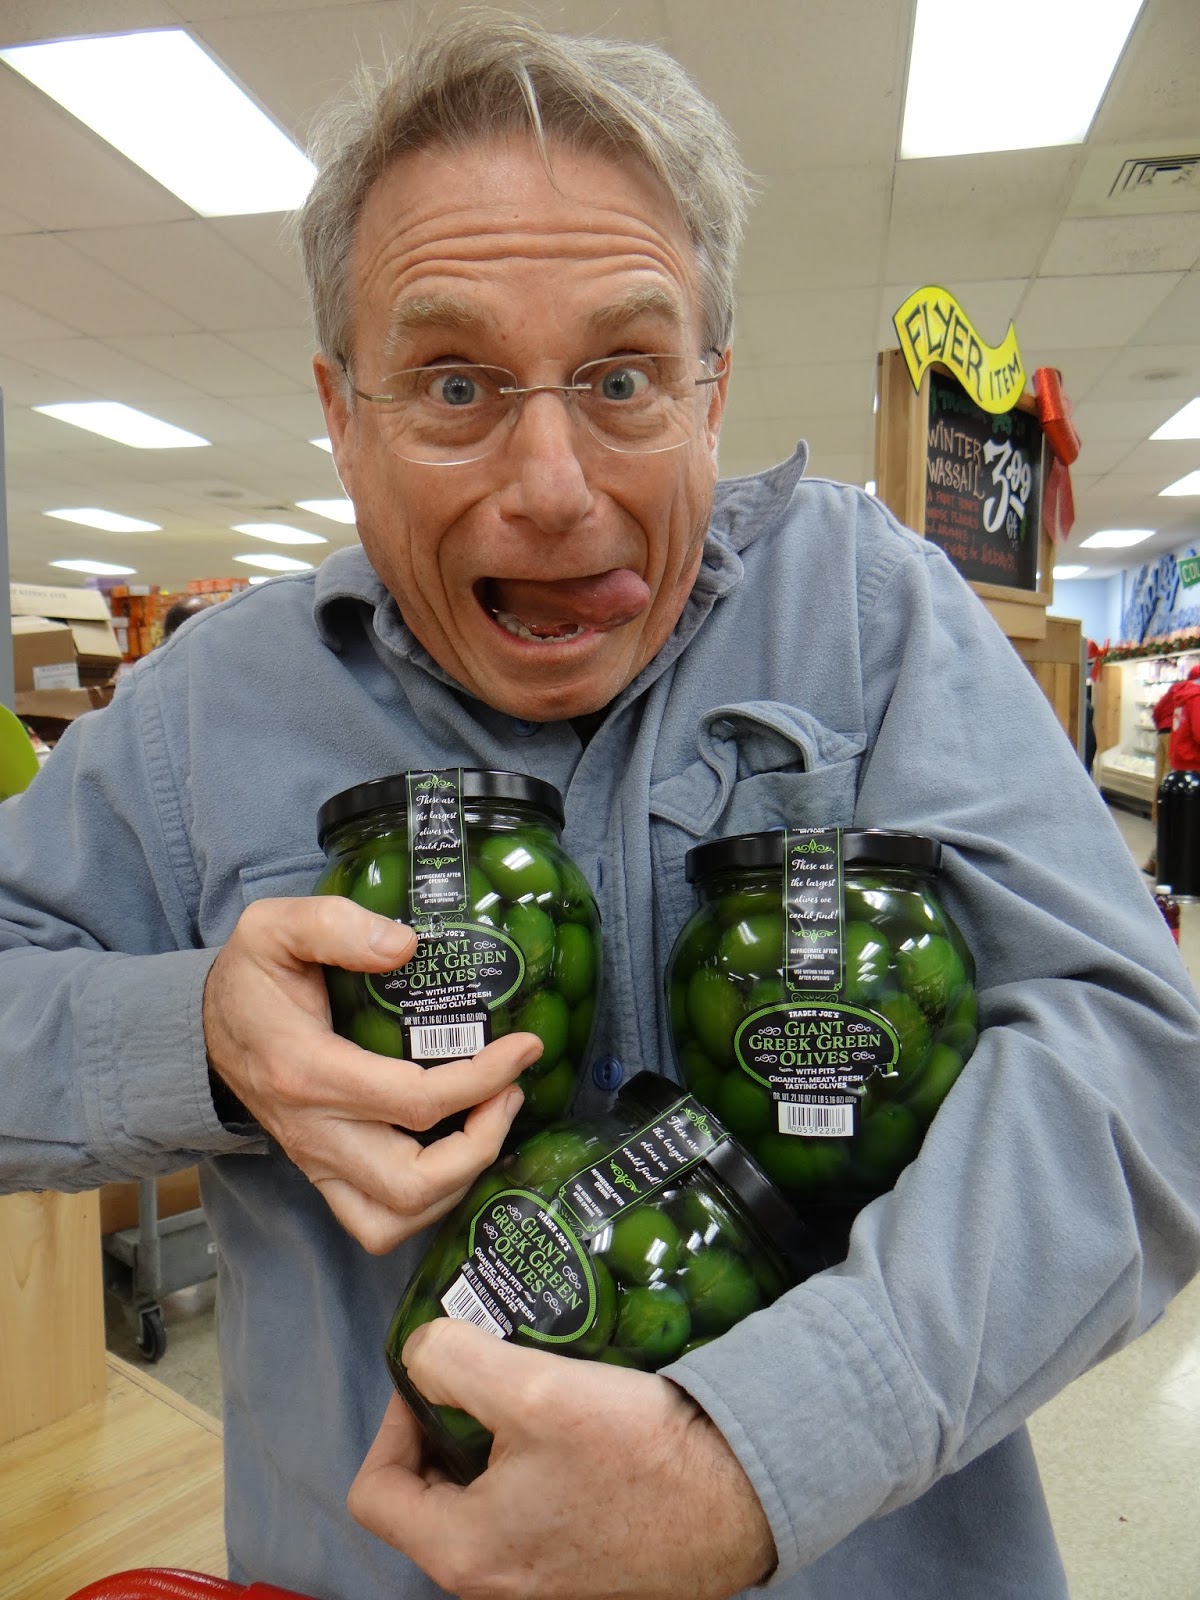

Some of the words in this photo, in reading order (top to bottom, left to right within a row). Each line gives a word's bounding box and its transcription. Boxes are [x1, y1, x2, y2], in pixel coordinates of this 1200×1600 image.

[905, 300, 983, 402] FLYER
[990, 353, 1021, 400] ITEM
[928, 420, 982, 468] WINTER
[927, 457, 985, 499] WASSAIL
[416, 796, 439, 806] These
[416, 811, 428, 821] the
[430, 811, 458, 822] largest
[419, 828, 442, 836] olives
[414, 842, 437, 851] could
[436, 839, 460, 851] find!
[792, 858, 818, 871] These
[790, 878, 804, 887] the
[806, 878, 836, 890] largest
[789, 911, 813, 919] could
[812, 910, 838, 922] find!
[414, 939, 470, 958] GIANT
[444, 950, 506, 968] GREEN
[409, 968, 476, 989] OLIVES
[400, 998, 438, 1008] GIGANTIC,
[439, 994, 466, 1002] MEATY,
[467, 991, 492, 999] FRESH
[426, 988, 446, 996] WITH
[415, 1004, 448, 1013] TASTING
[449, 999, 477, 1008] OLIVES
[422, 1015, 435, 1024] 21.16
[448, 1014, 454, 1023] LB
[788, 1010, 817, 1018] TRADER
[818, 1010, 840, 1019] JOE'S
[784, 1021, 844, 1037] GIANT
[748, 1034, 811, 1050] GREEK
[816, 1034, 882, 1050] GREEN
[779, 1050, 849, 1066] OLIVES
[768, 1076, 808, 1084] GIGANTIC,
[796, 1068, 817, 1076] WITH
[791, 1093, 804, 1102] 21.16
[667, 1116, 688, 1141] These
[686, 1138, 699, 1152] are
[652, 1126, 665, 1140] the
[663, 1138, 688, 1164] largest
[640, 1141, 661, 1162] olives
[658, 1159, 669, 1172] we
[622, 1147, 645, 1168] could
[635, 1165, 662, 1186] find!
[611, 1192, 625, 1207] AFTER
[537, 1210, 558, 1236] TRADER
[555, 1232, 571, 1252] JOE'S
[520, 1217, 567, 1265] GIANT
[491, 1205, 532, 1254] GREEK
[529, 1251, 583, 1311] GREEN
[495, 1236, 545, 1294] OLIVES
[495, 1259, 510, 1279] WITH
[508, 1276, 524, 1292] PITS
[475, 1247, 497, 1278] GIGANTIC,
[496, 1275, 517, 1300] MEATY,
[514, 1297, 536, 1322] FRESH
[477, 1263, 499, 1290] TASTING
[497, 1288, 518, 1313] OLIVES
